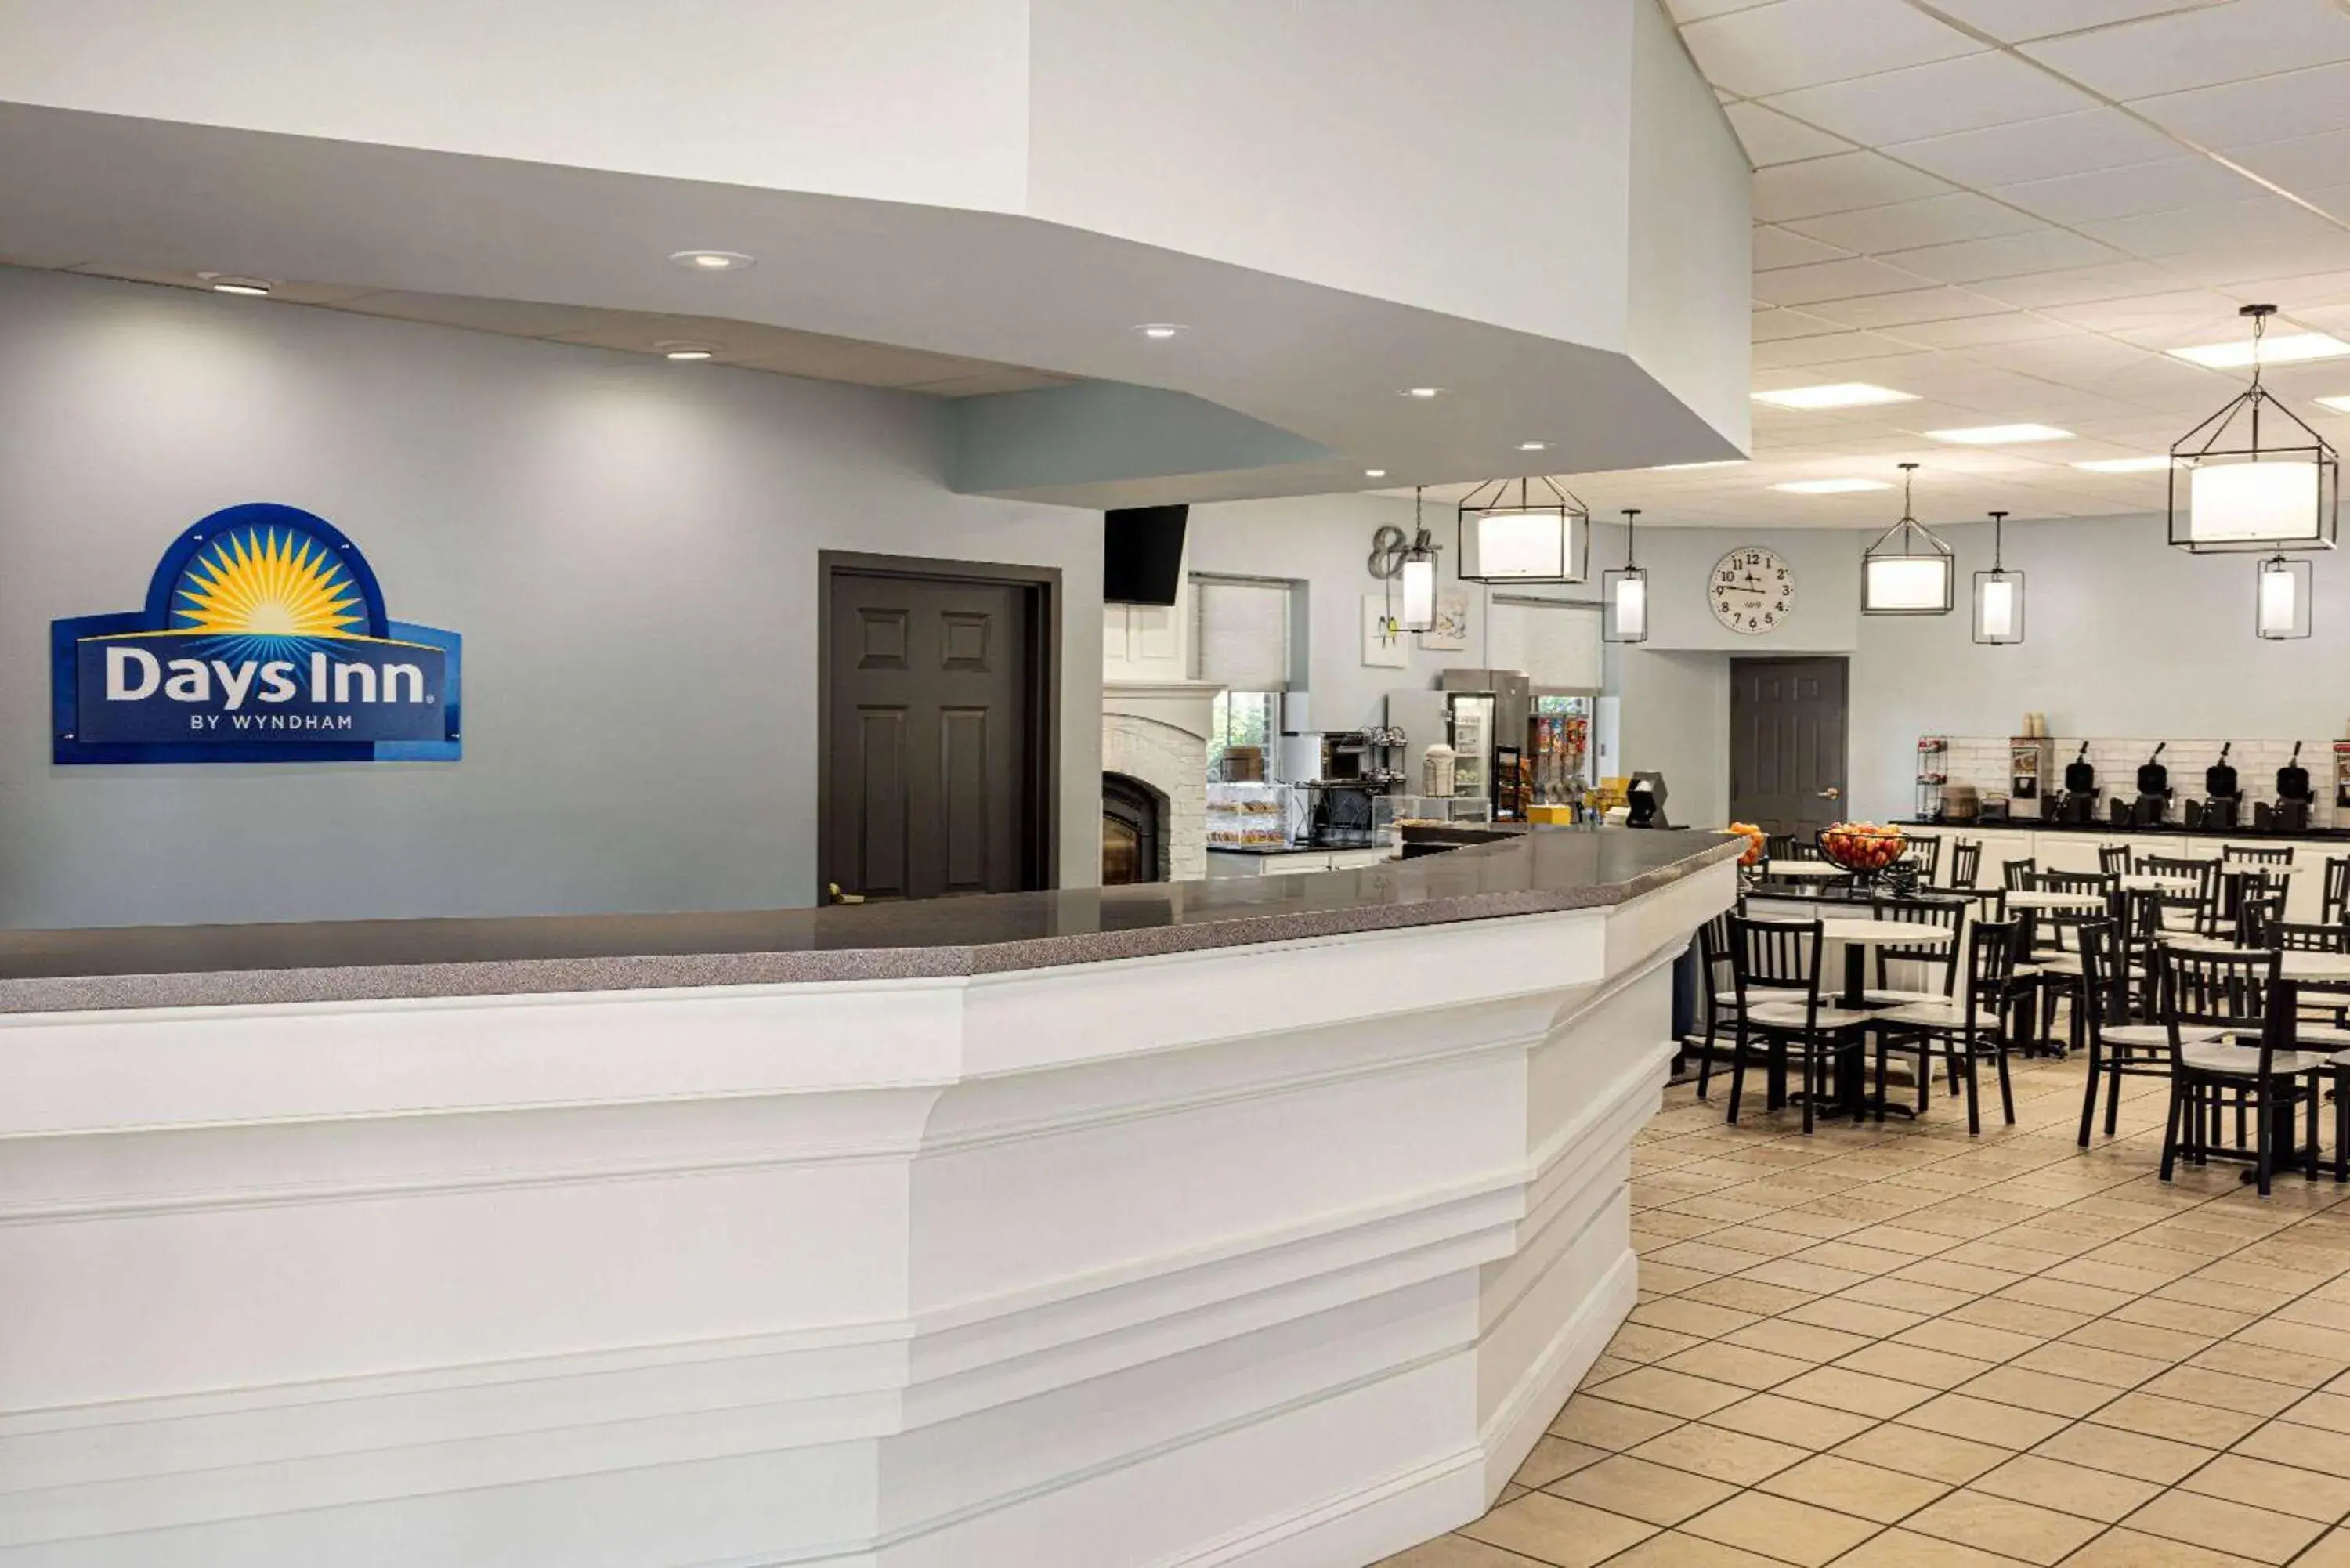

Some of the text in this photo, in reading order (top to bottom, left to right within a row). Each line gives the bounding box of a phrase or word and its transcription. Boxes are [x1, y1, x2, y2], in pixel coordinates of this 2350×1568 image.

[1733, 558, 1743, 570] 11
[1746, 553, 1759, 565] 12
[1721, 570, 1735, 582] 10
[1777, 568, 1785, 580] 2
[1716, 585, 1724, 598] 9
[1782, 585, 1790, 596] 3
[1722, 601, 1730, 613] 8
[1775, 601, 1784, 612] 4
[1734, 612, 1741, 624] 7
[1748, 617, 1757, 628] 6
[1764, 612, 1773, 624] 5
[105, 645, 425, 711] Days Inn
[190, 714, 352, 730] BY WYNDHAM
